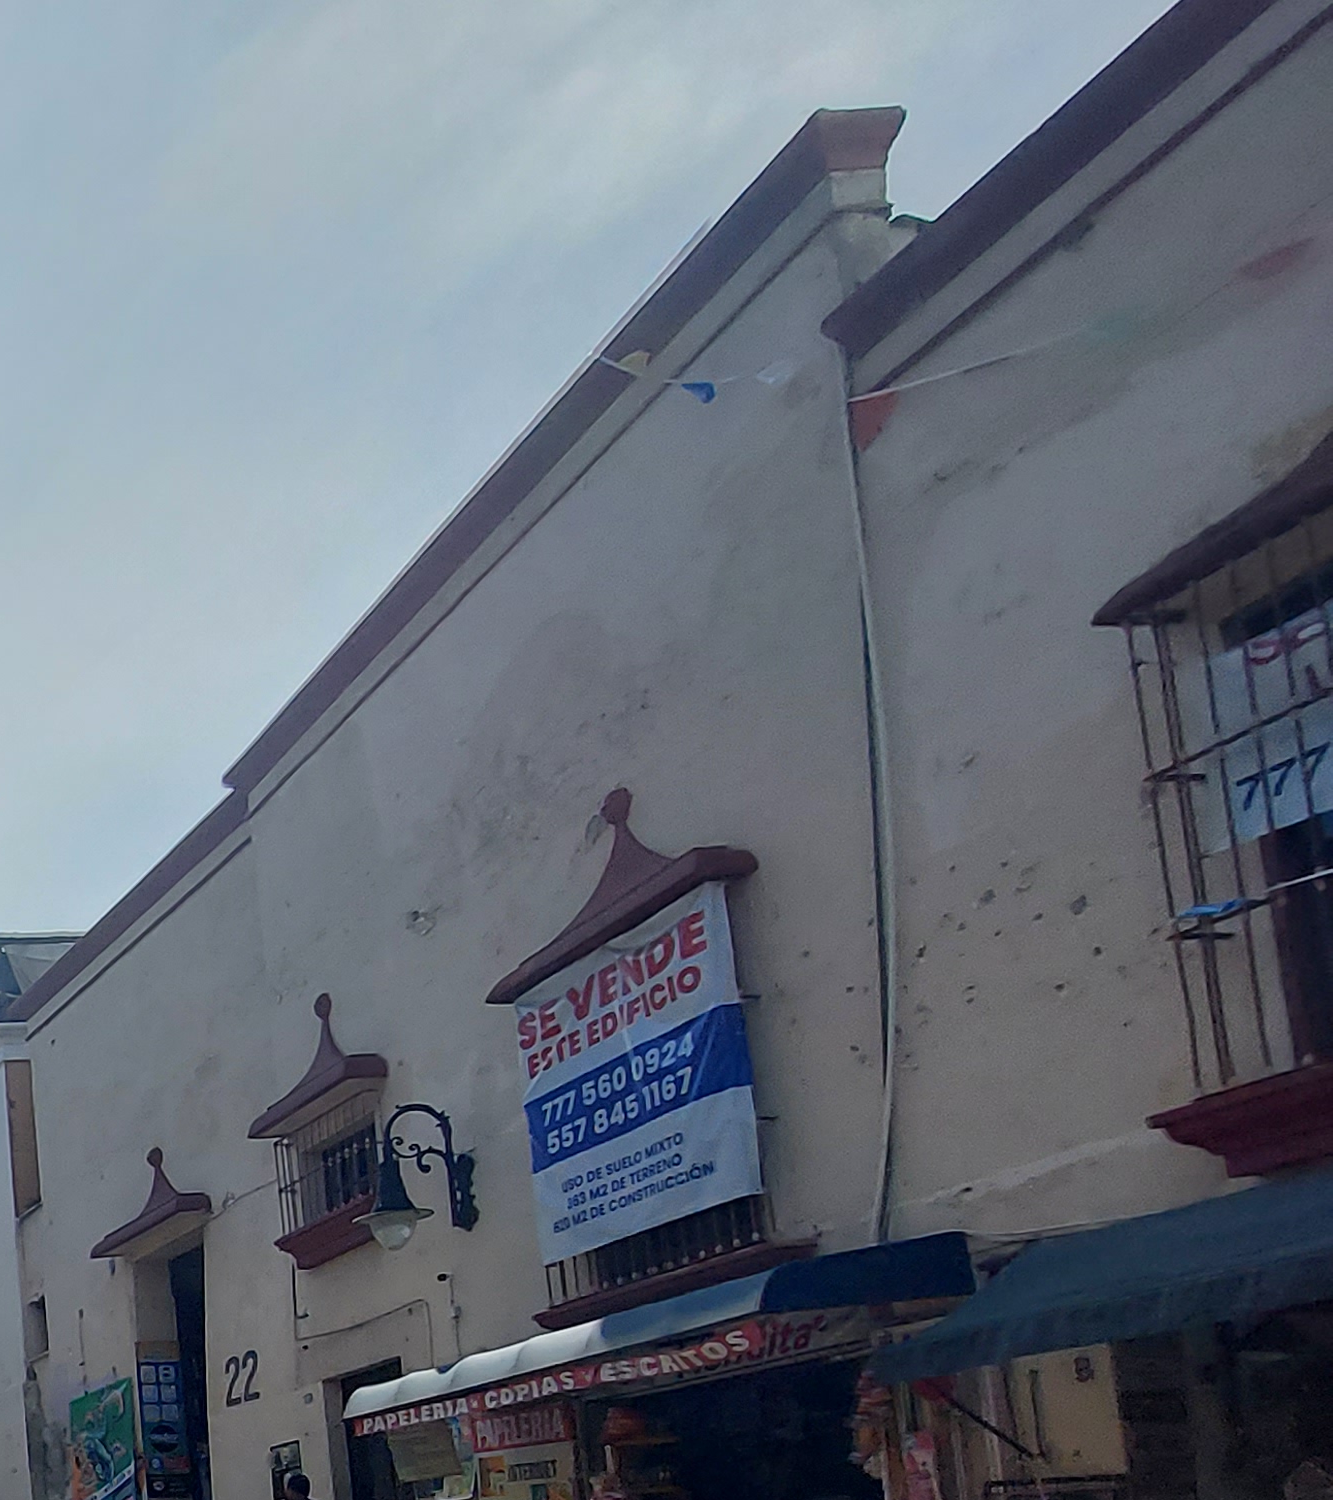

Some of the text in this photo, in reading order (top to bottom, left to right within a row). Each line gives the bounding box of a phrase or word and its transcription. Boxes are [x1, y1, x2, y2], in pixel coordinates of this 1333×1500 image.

[517, 910, 708, 1050] SE VENDE
[527, 965, 702, 1080] ESTE EDIFICIO
[541, 1031, 695, 1127] 777 560 0924
[546, 1066, 693, 1155] 557 845 1167
[561, 1132, 684, 1194] USO DE SUELO MIXTO
[572, 1208, 590, 1226] M2
[590, 1201, 606, 1220] DE
[607, 1160, 716, 1213] CONSTRUCCIÓN
[589, 1183, 609, 1201] M2
[611, 1175, 627, 1192] DE
[630, 1153, 683, 1186] TERRENO
[223, 1349, 261, 1408] 22
[362, 1397, 470, 1435] PAPELERIA
[484, 1370, 575, 1409] COPIAS
[599, 1329, 751, 1383] ESCRITOS
